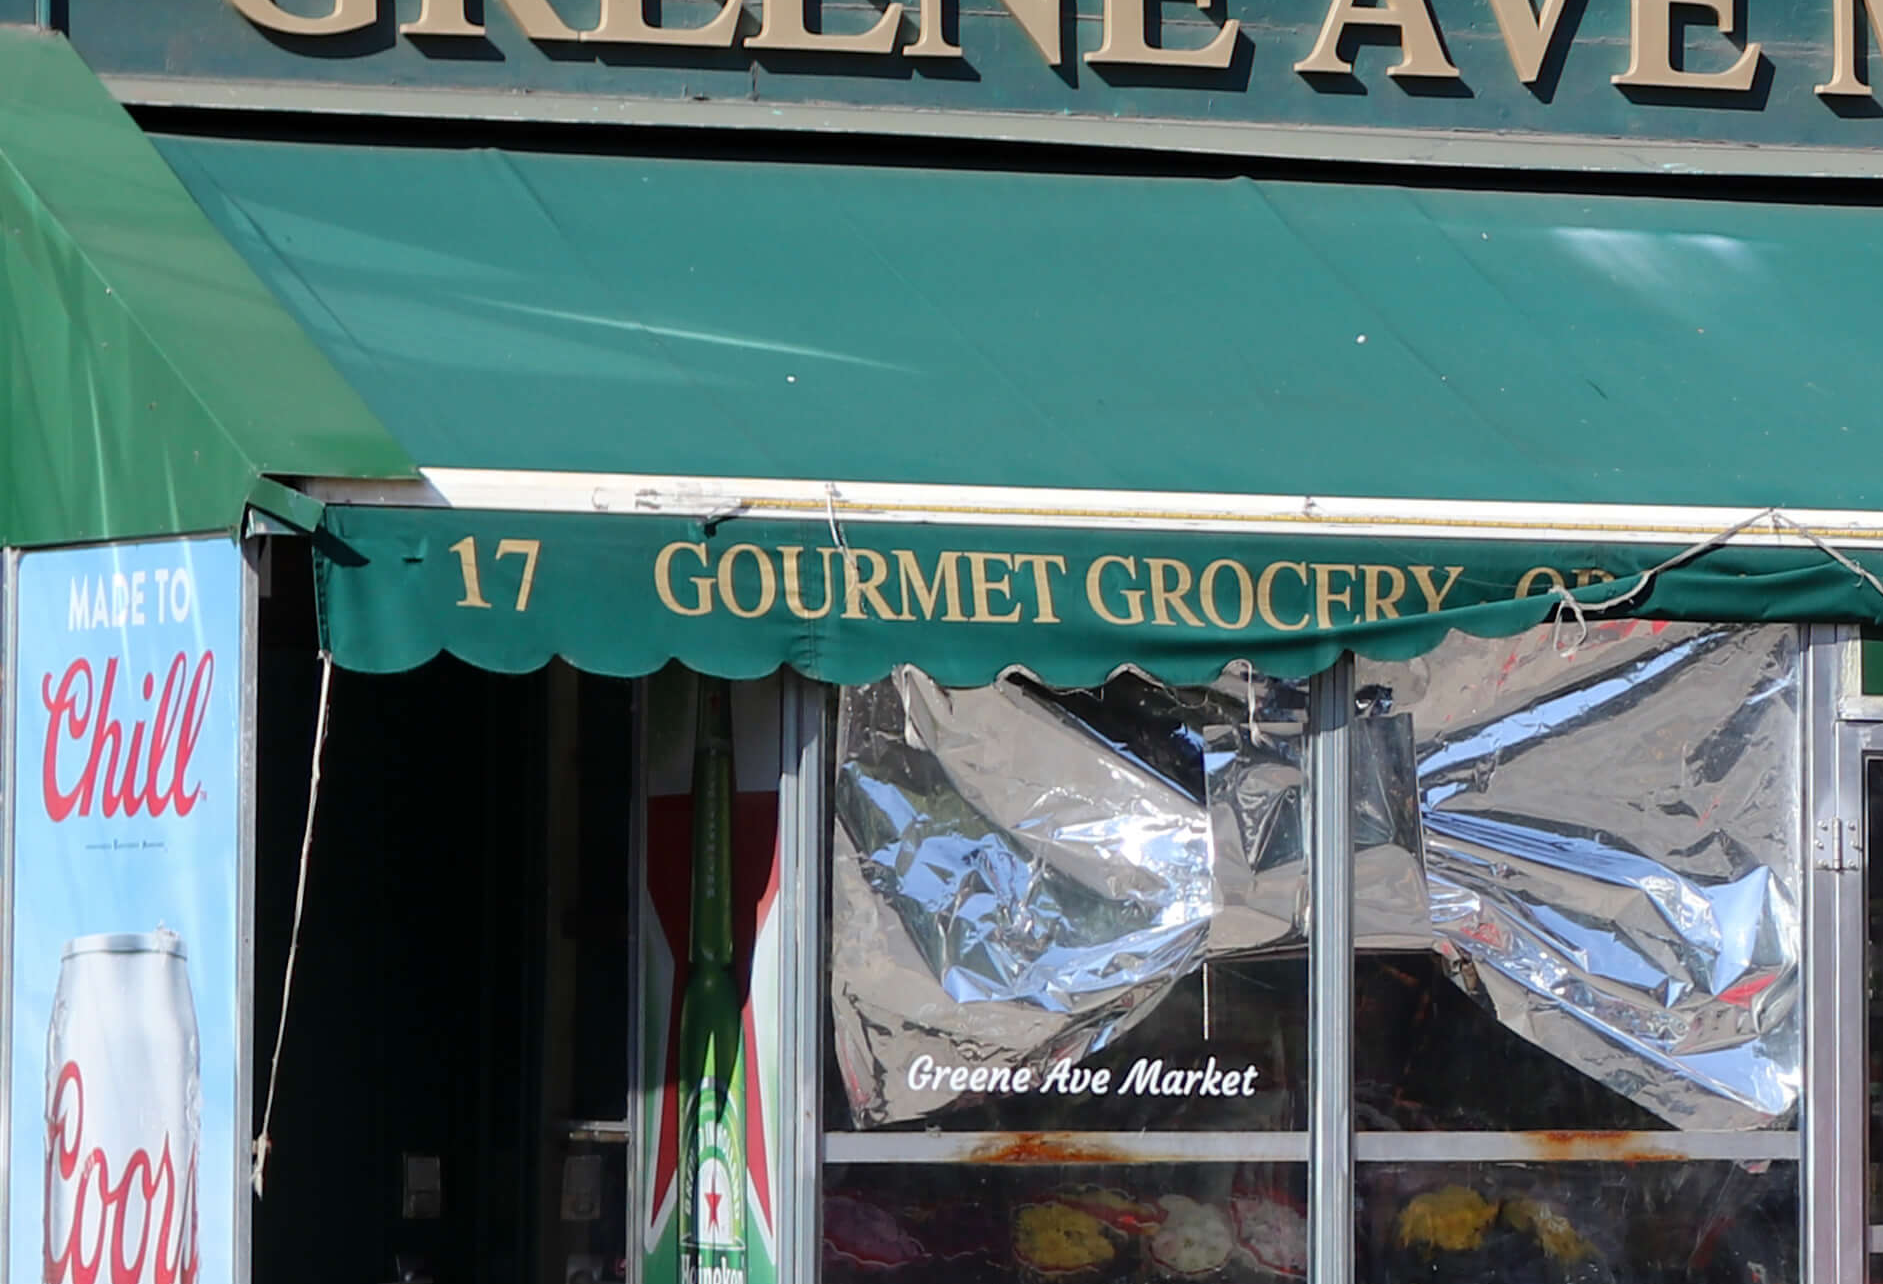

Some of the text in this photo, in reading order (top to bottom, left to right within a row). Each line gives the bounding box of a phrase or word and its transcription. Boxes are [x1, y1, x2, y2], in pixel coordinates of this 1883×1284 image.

[67, 567, 193, 632] MADE TO
[448, 535, 541, 614] 17
[652, 539, 1069, 625] GOURMET
[1085, 554, 1464, 630] GROCERY
[42, 649, 214, 823] Chill
[906, 1054, 1259, 1098] Greene Ave Market
